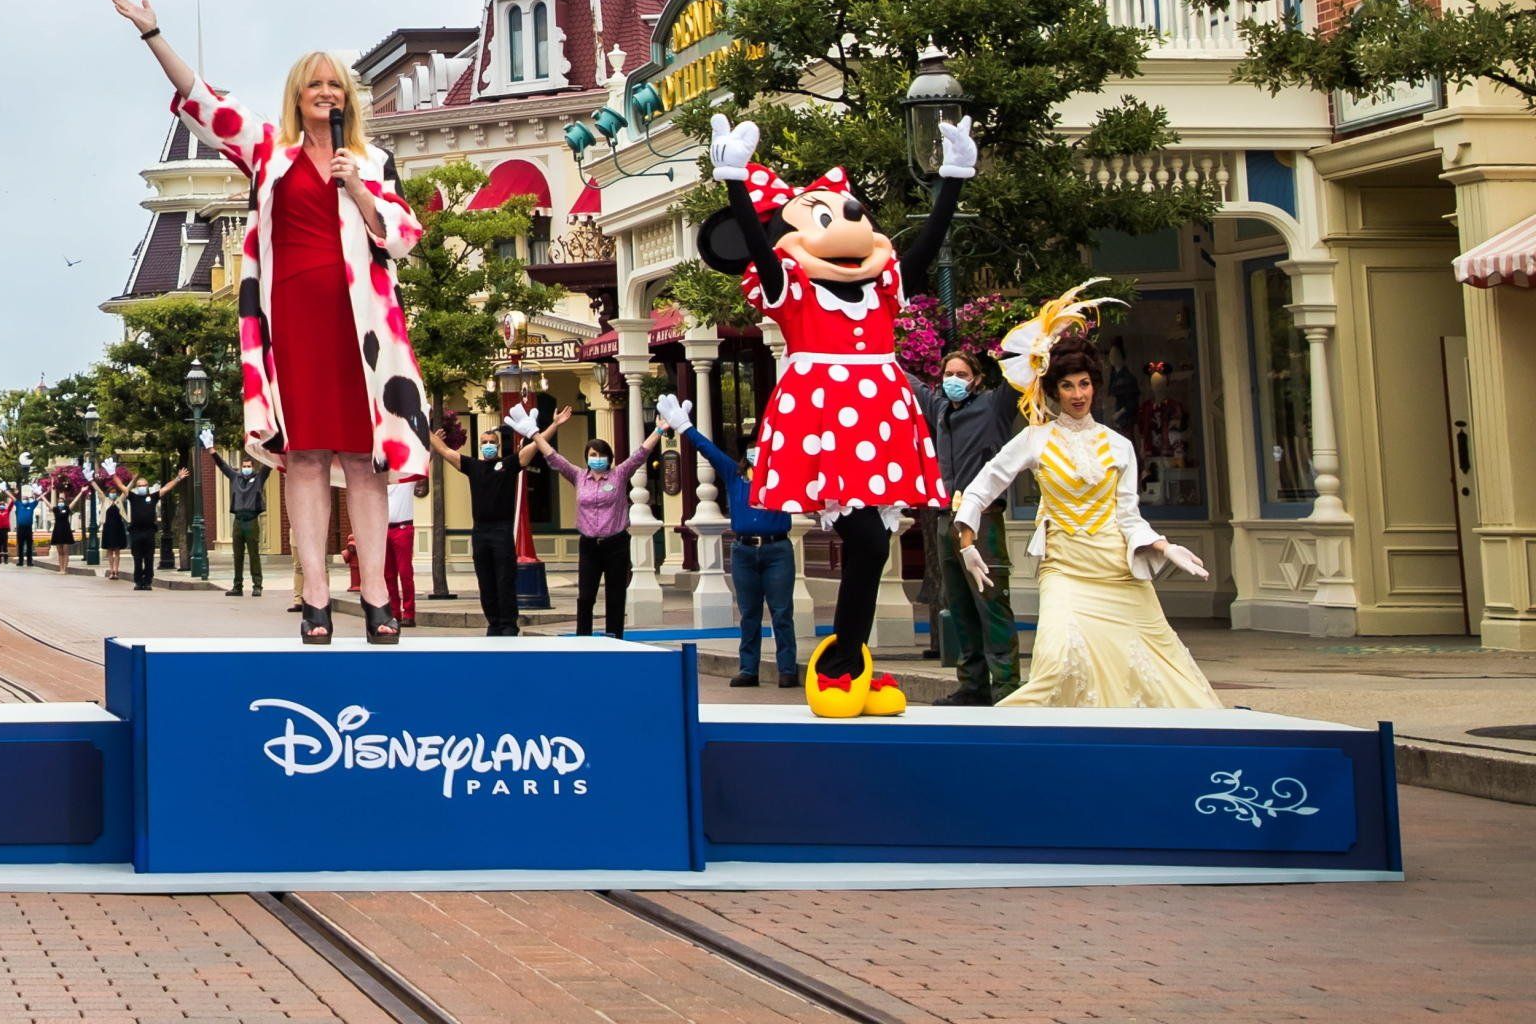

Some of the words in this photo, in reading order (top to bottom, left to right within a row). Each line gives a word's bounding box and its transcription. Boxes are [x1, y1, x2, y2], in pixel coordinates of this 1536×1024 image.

[654, 39, 742, 114] OTHIE
[485, 342, 576, 360] ICESSEN
[467, 779, 588, 795] PARIS
